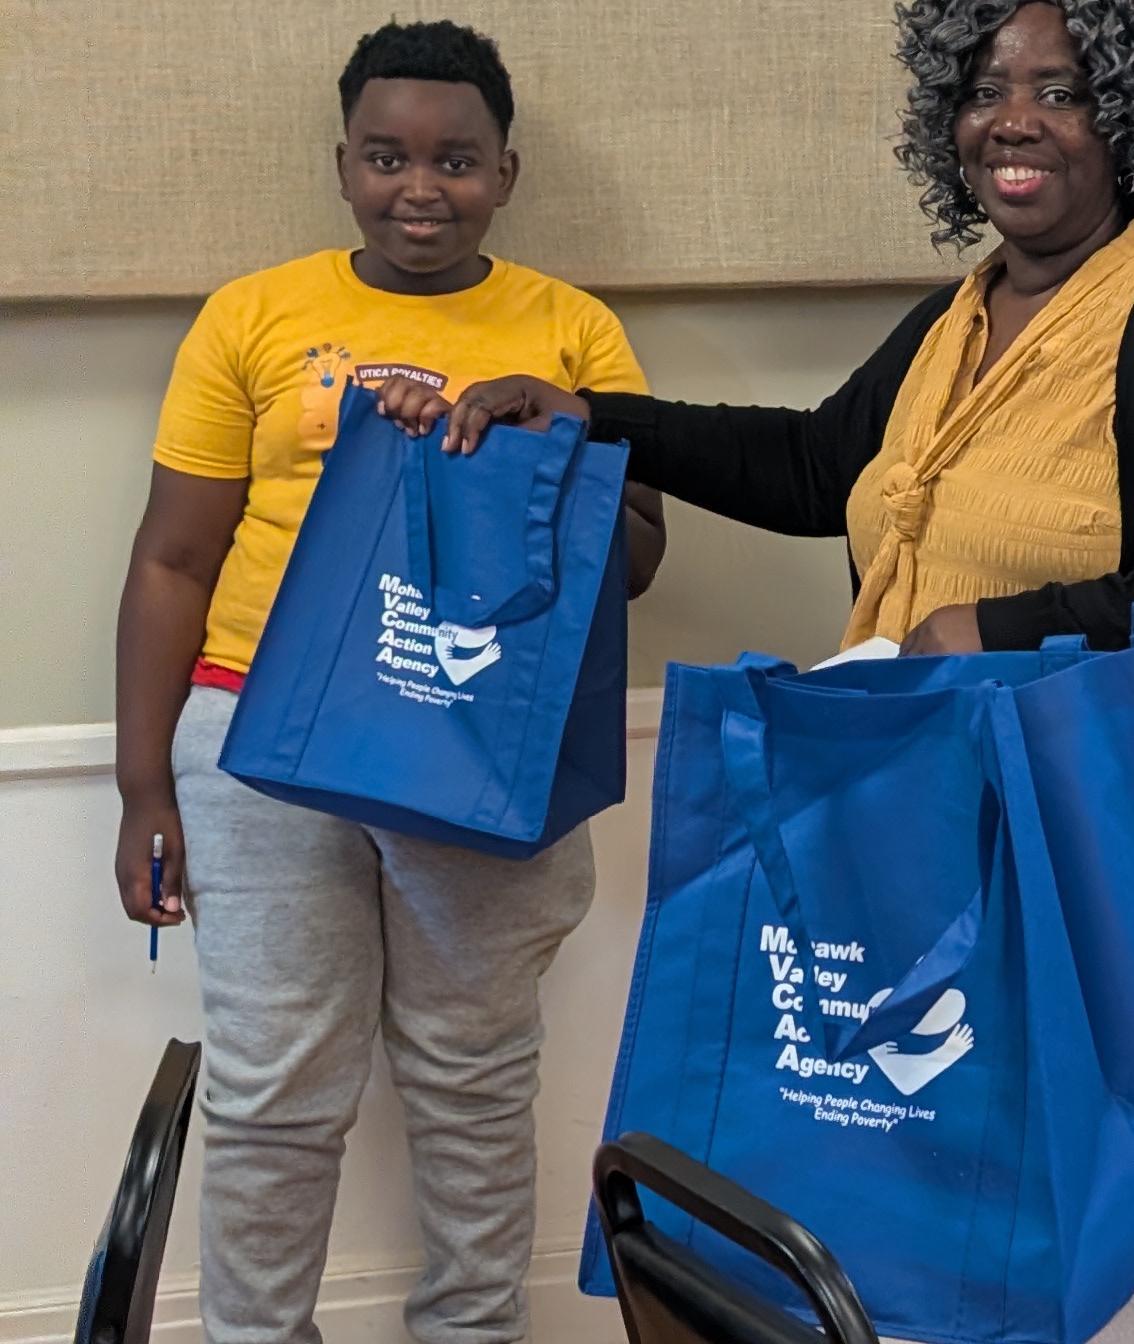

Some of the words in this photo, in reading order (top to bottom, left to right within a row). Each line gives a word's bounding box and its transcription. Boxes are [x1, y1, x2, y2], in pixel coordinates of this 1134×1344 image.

[359, 367, 389, 379] UTICA
[378, 573, 424, 600] Moha
[383, 592, 431, 621] Valley
[381, 611, 459, 643] Community
[377, 629, 433, 656] Action
[375, 646, 440, 678] Agency
[775, 1043, 869, 1084] Agency
[814, 1107, 850, 1127] Ending
[824, 1093, 858, 1110] People
[860, 1098, 907, 1119] Changing
[908, 1105, 936, 1121] Lives
